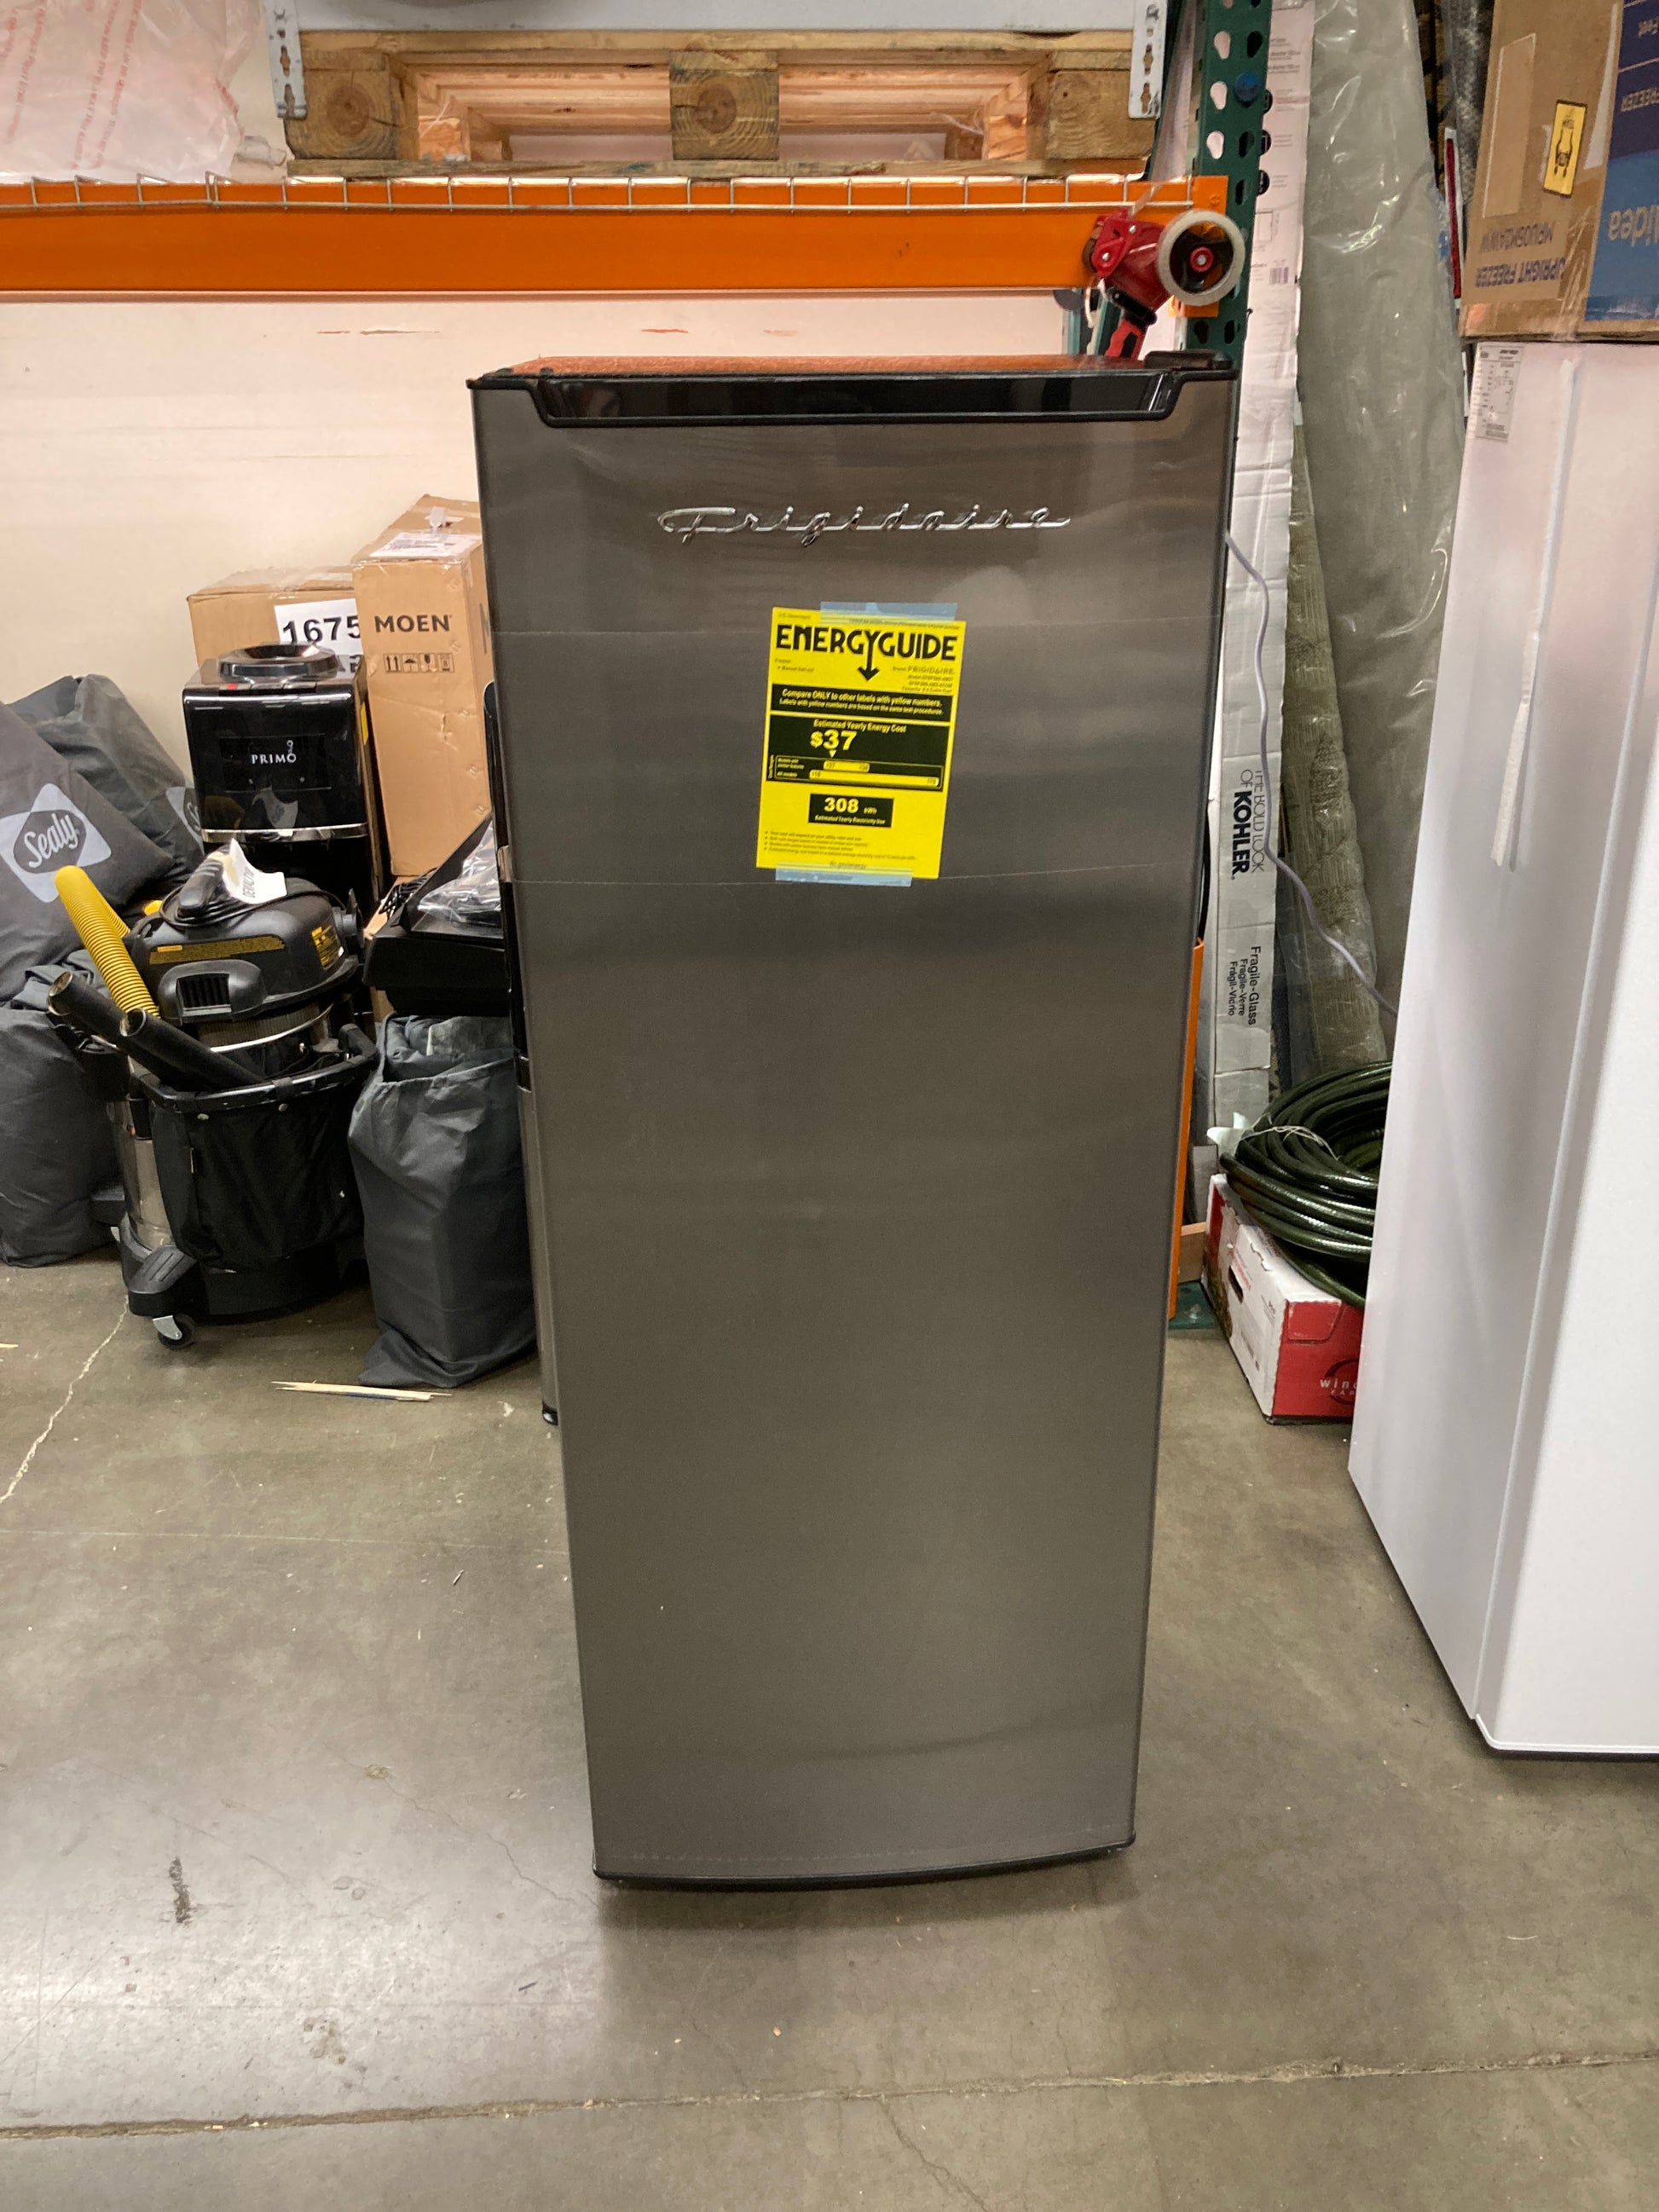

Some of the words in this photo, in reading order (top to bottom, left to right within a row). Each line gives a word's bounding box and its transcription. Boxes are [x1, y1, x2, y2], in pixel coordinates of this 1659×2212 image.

[1476, 263, 1516, 287] FREEZER
[657, 503, 1071, 546] Frigidaire
[374, 615, 450, 632] MOEN
[776, 624, 957, 661] ENERGYGUIDE
[782, 688, 812, 699] Compare
[812, 690, 831, 699] ONLY
[839, 693, 856, 702] other
[857, 693, 876, 702] labels
[876, 695, 890, 703] with
[891, 696, 911, 706] yellow
[810, 729, 857, 750] $37
[813, 719, 846, 729] Estimated
[847, 721, 867, 731] Yearly
[867, 722, 890, 733] Energy
[891, 724, 906, 733] Cost
[251, 750, 297, 764] PRIMO
[1240, 769, 1253, 788] OF
[824, 797, 859, 813] 308
[1253, 795, 1265, 832] BOLD
[24, 812, 78, 868] Sealy
[1232, 790, 1252, 876] KOHLER
[1251, 835, 1265, 873] LOOK
[1238, 958, 1248, 1016] Fragile-Verre
[1247, 945, 1262, 1025] Fragile-Glass
